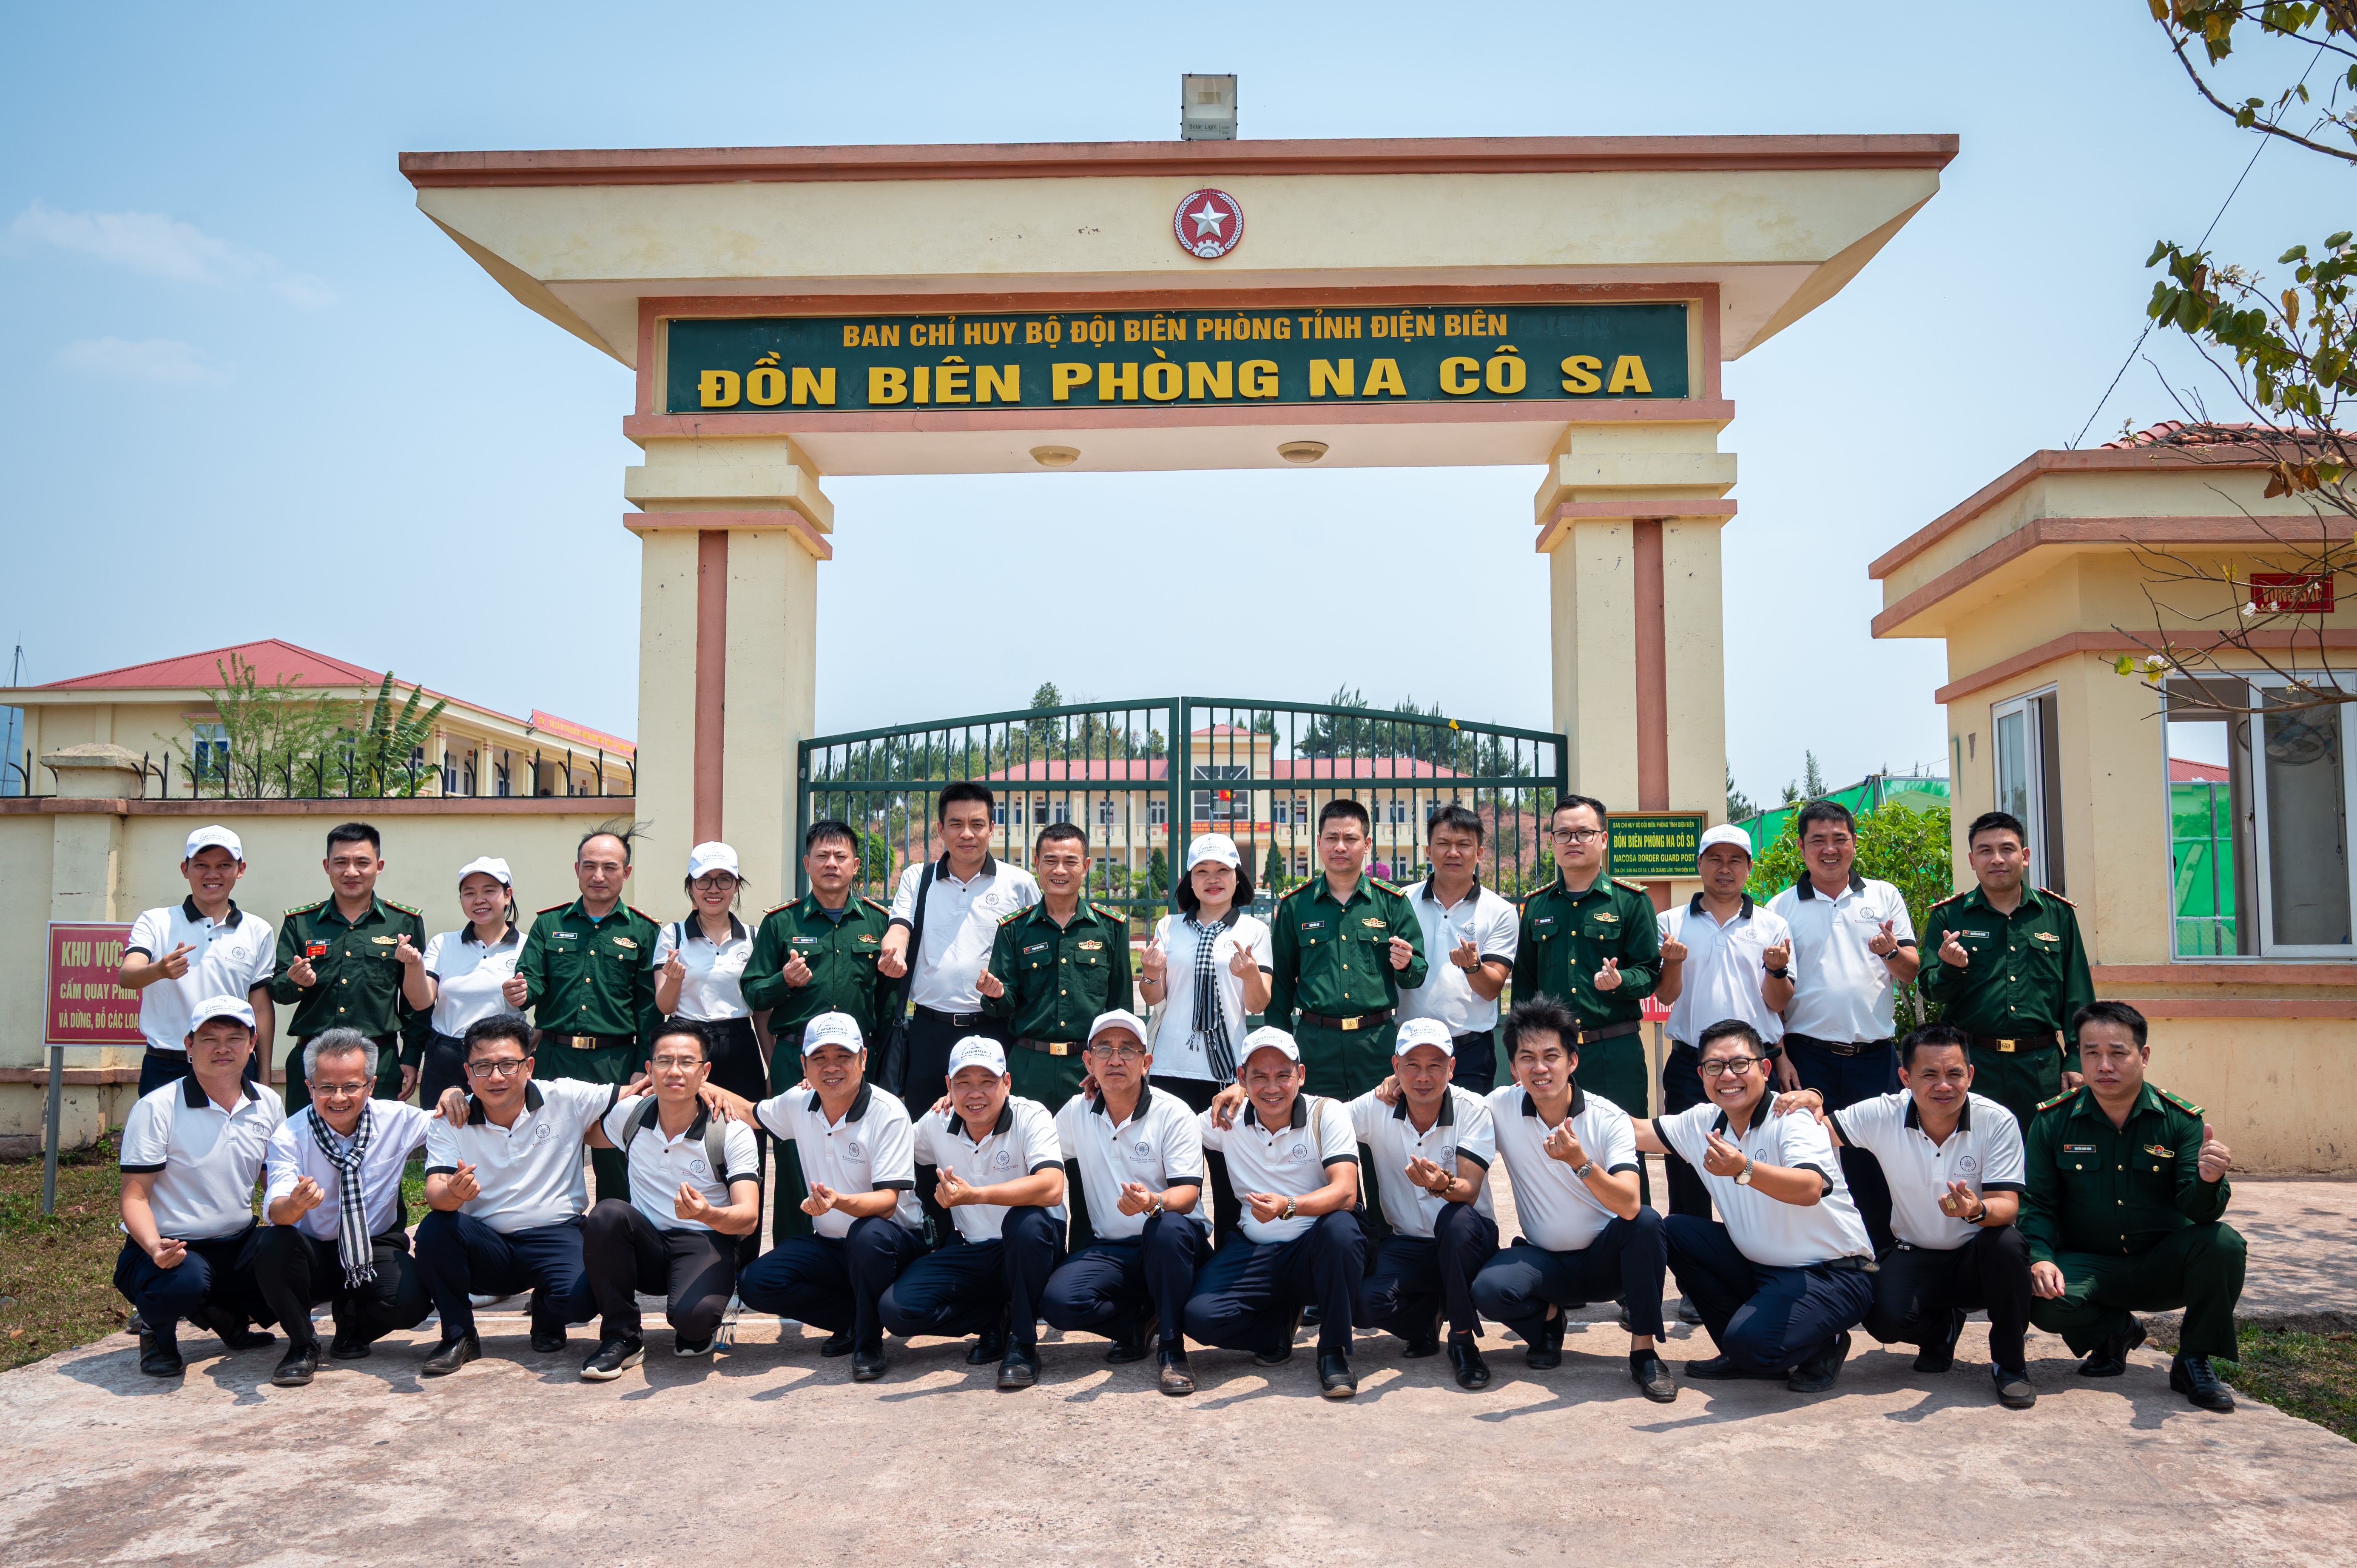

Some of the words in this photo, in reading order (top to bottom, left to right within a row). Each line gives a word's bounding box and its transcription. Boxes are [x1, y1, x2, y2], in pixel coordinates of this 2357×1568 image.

[843, 324, 901, 347] BAN
[910, 315, 956, 346] CHỈ
[964, 321, 1017, 346] HUY
[1026, 315, 1061, 349] BỘ
[1070, 315, 1115, 348] ĐỘI
[1124, 314, 1186, 341] BIÊN
[1196, 312, 1291, 341] PHÒNG
[1298, 309, 1362, 339] TỈNH
[1370, 310, 1435, 343] ĐIỆN
[1444, 309, 1507, 337] BIÊN
[698, 350, 837, 408] ĐỒN
[868, 355, 1020, 404] BIÊN
[1051, 346, 1278, 402] PHÒNG
[1309, 358, 1407, 397] NA
[1440, 345, 1527, 395] CÔ
[1561, 354, 1653, 394] SA
[1614, 831, 1626, 848] ĐỒN
[1628, 832, 1642, 848] BIÊN
[1644, 832, 1665, 848] PHÒNG
[1666, 835, 1675, 847] NA
[1676, 832, 1685, 847] CÔ
[1686, 835, 1695, 847] SA
[1614, 854, 1637, 862] NACOSA
[1638, 854, 1659, 862] BORDER
[1660, 854, 1680, 862] GUARD
[1681, 854, 1695, 862] POST
[61, 941, 91, 967] KHU
[95, 939, 124, 973] VỰC
[60, 978, 82, 999] CẤM
[84, 983, 110, 1001] QUAY
[59, 1008, 68, 1028] VÀ
[70, 1008, 94, 1031] DỪNG,
[95, 1007, 106, 1029] ĐỖ
[108, 1009, 123, 1029] CÁC
